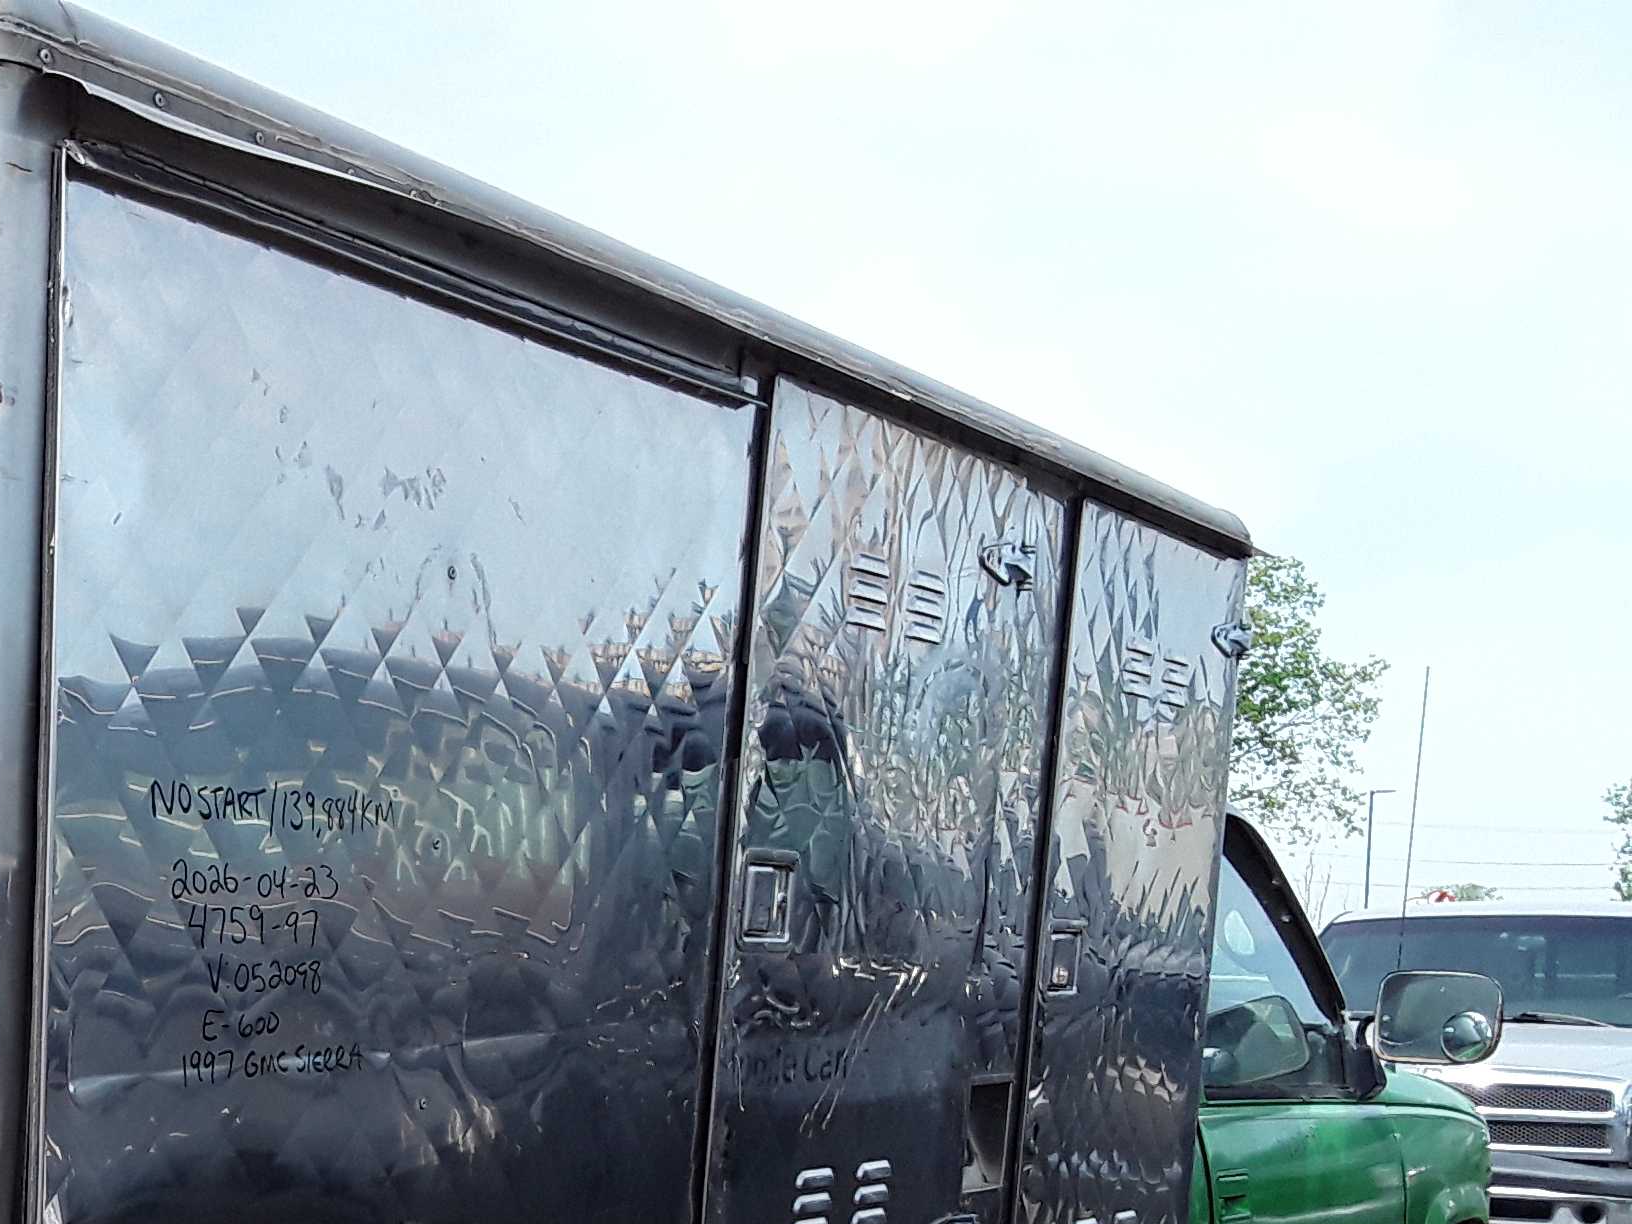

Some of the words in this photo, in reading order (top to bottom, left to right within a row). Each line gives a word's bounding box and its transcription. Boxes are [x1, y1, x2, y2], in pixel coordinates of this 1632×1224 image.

[171, 858, 339, 899] 2026-04-23
[187, 904, 319, 948] 4759-97
[182, 1050, 234, 1087] 1997
[244, 1052, 286, 1079] GMC
[296, 1041, 363, 1074] SIERRA
